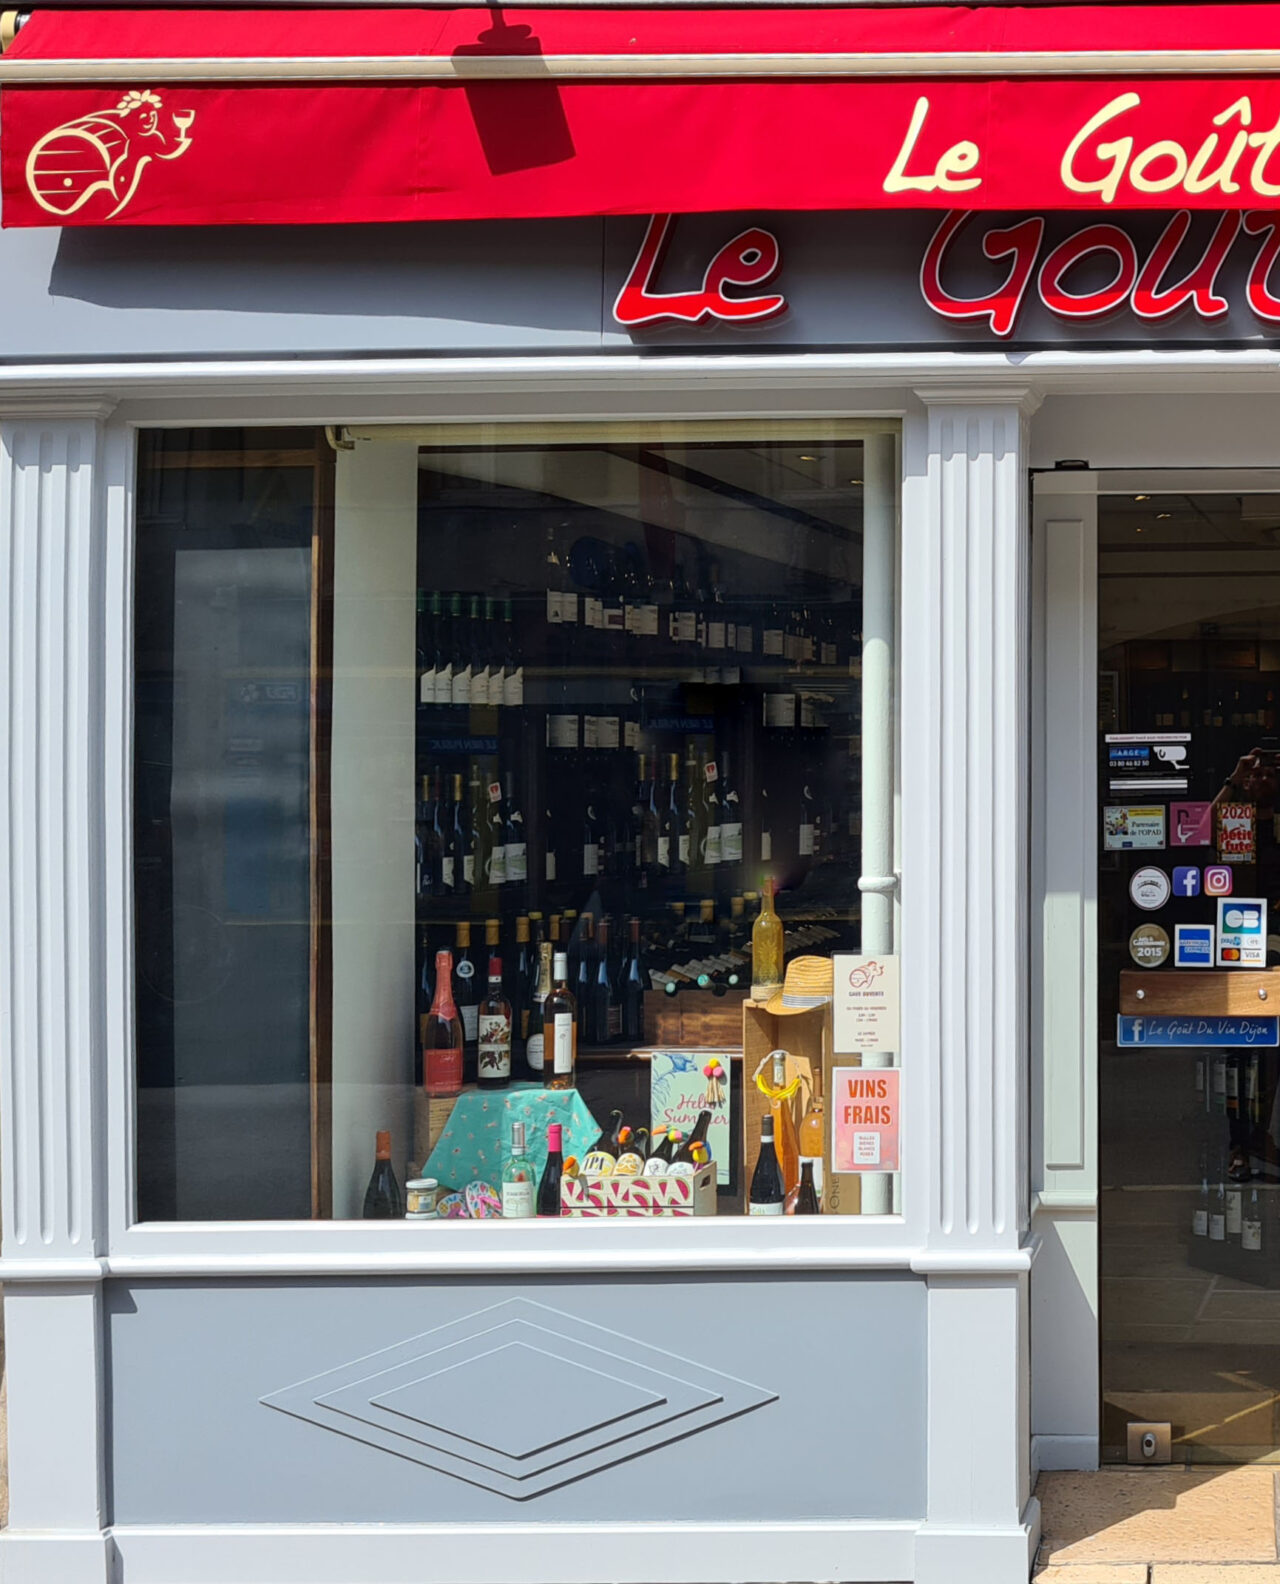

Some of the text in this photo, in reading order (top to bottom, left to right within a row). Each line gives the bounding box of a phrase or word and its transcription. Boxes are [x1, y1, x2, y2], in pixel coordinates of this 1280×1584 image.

[883, 96, 982, 193] Le
[613, 213, 786, 325] Le
[1222, 805, 1253, 819] 2020
[1137, 947, 1162, 957] 2015
[1148, 1021, 1163, 1035] Le
[1197, 1020, 1214, 1035] Du
[1218, 1020, 1236, 1035] Vin
[1239, 1021, 1269, 1042] Dijon
[848, 1079, 887, 1098] VINS
[662, 1108, 728, 1125] Sumer
[844, 1105, 891, 1125] FRAIS
